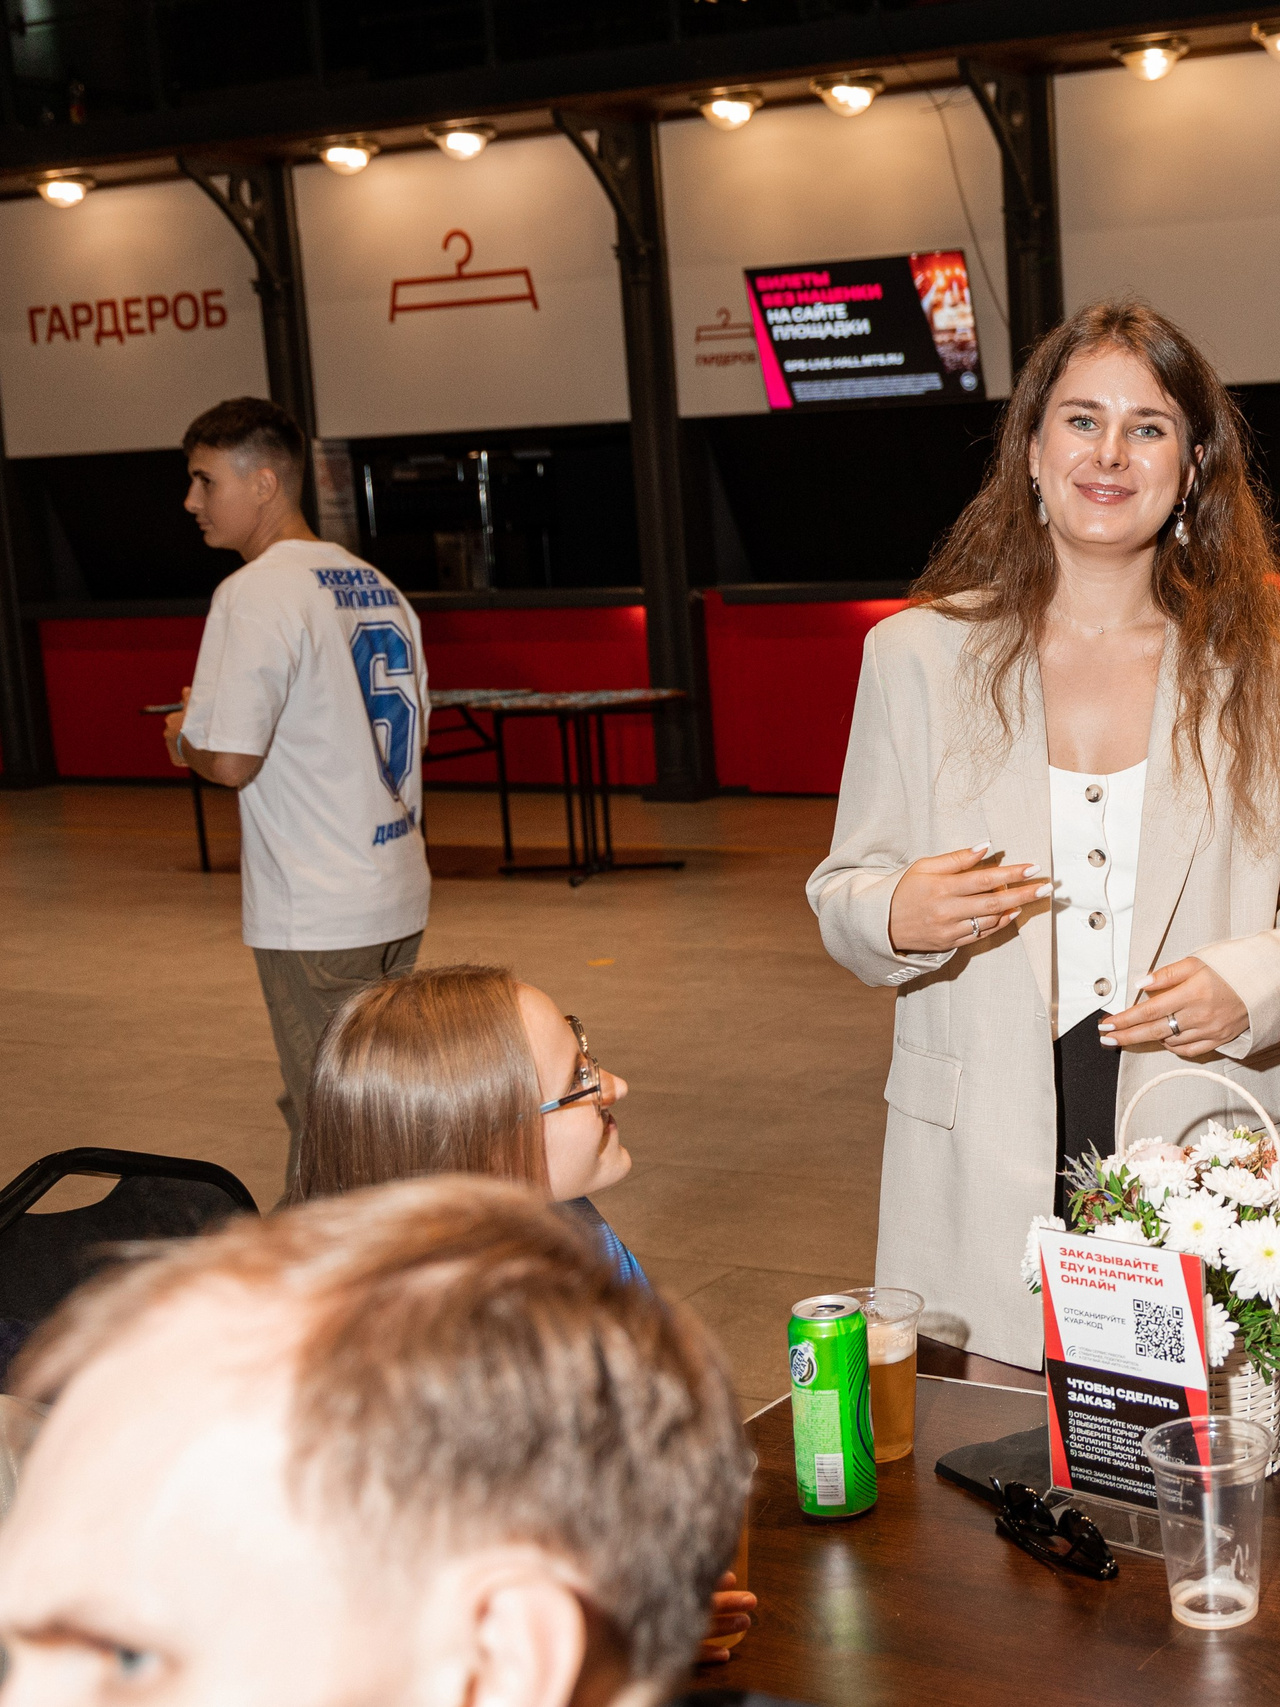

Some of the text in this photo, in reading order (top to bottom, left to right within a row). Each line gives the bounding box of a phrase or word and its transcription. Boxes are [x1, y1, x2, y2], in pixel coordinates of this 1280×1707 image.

[27, 288, 228, 346] ГАРДЕРОБ
[766, 302, 848, 324] НА САЙТЕ
[772, 318, 870, 340] ПЛОЩАДКИ
[312, 568, 380, 587] КВИЗ
[350, 620, 415, 801] 6
[1059, 1247, 1159, 1272] ЗАКАЗЫВАЙТЕ
[1060, 1261, 1163, 1287] ЕДУ И НАПИТКИ
[1061, 1275, 1116, 1292] ОНЛАЙН
[1064, 1307, 1126, 1325] ОТСКАНИРУЙТЕ
[1064, 1317, 1103, 1330] КУАР-КОД
[792, 1350, 805, 1376] GREEN
[798, 1357, 808, 1377] BEAT
[1067, 1377, 1179, 1410] ЧТОБЫ СДЕЛАТЬ
[1068, 1391, 1116, 1410] ЗАКАЗ:
[1074, 1412, 1126, 1429] ОТСКАНИРУЙТЕ
[1076, 1420, 1111, 1433] ВЫБЕРИТЕ
[1112, 1428, 1139, 1438] КОРНЕР
[1077, 1428, 1111, 1441] ВЫБЕРИТЕ
[1112, 1436, 1125, 1444] ЕДУ
[1077, 1436, 1111, 1448] ОПЛАТИТЕ
[1112, 1444, 1134, 1453] ЗАКАЗ
[1070, 1442, 1084, 1450] СМС
[1092, 1447, 1136, 1462] ГОТОВНОСТИ
[1070, 1449, 1077, 1457] 5)
[1078, 1451, 1111, 1464] ЗАБЕРИТЕ
[1112, 1459, 1134, 1470] ЗАКАЗ
[1093, 1470, 1111, 1480] ЗАКАЗ
[1117, 1476, 1143, 1487] КАЖДОМ
